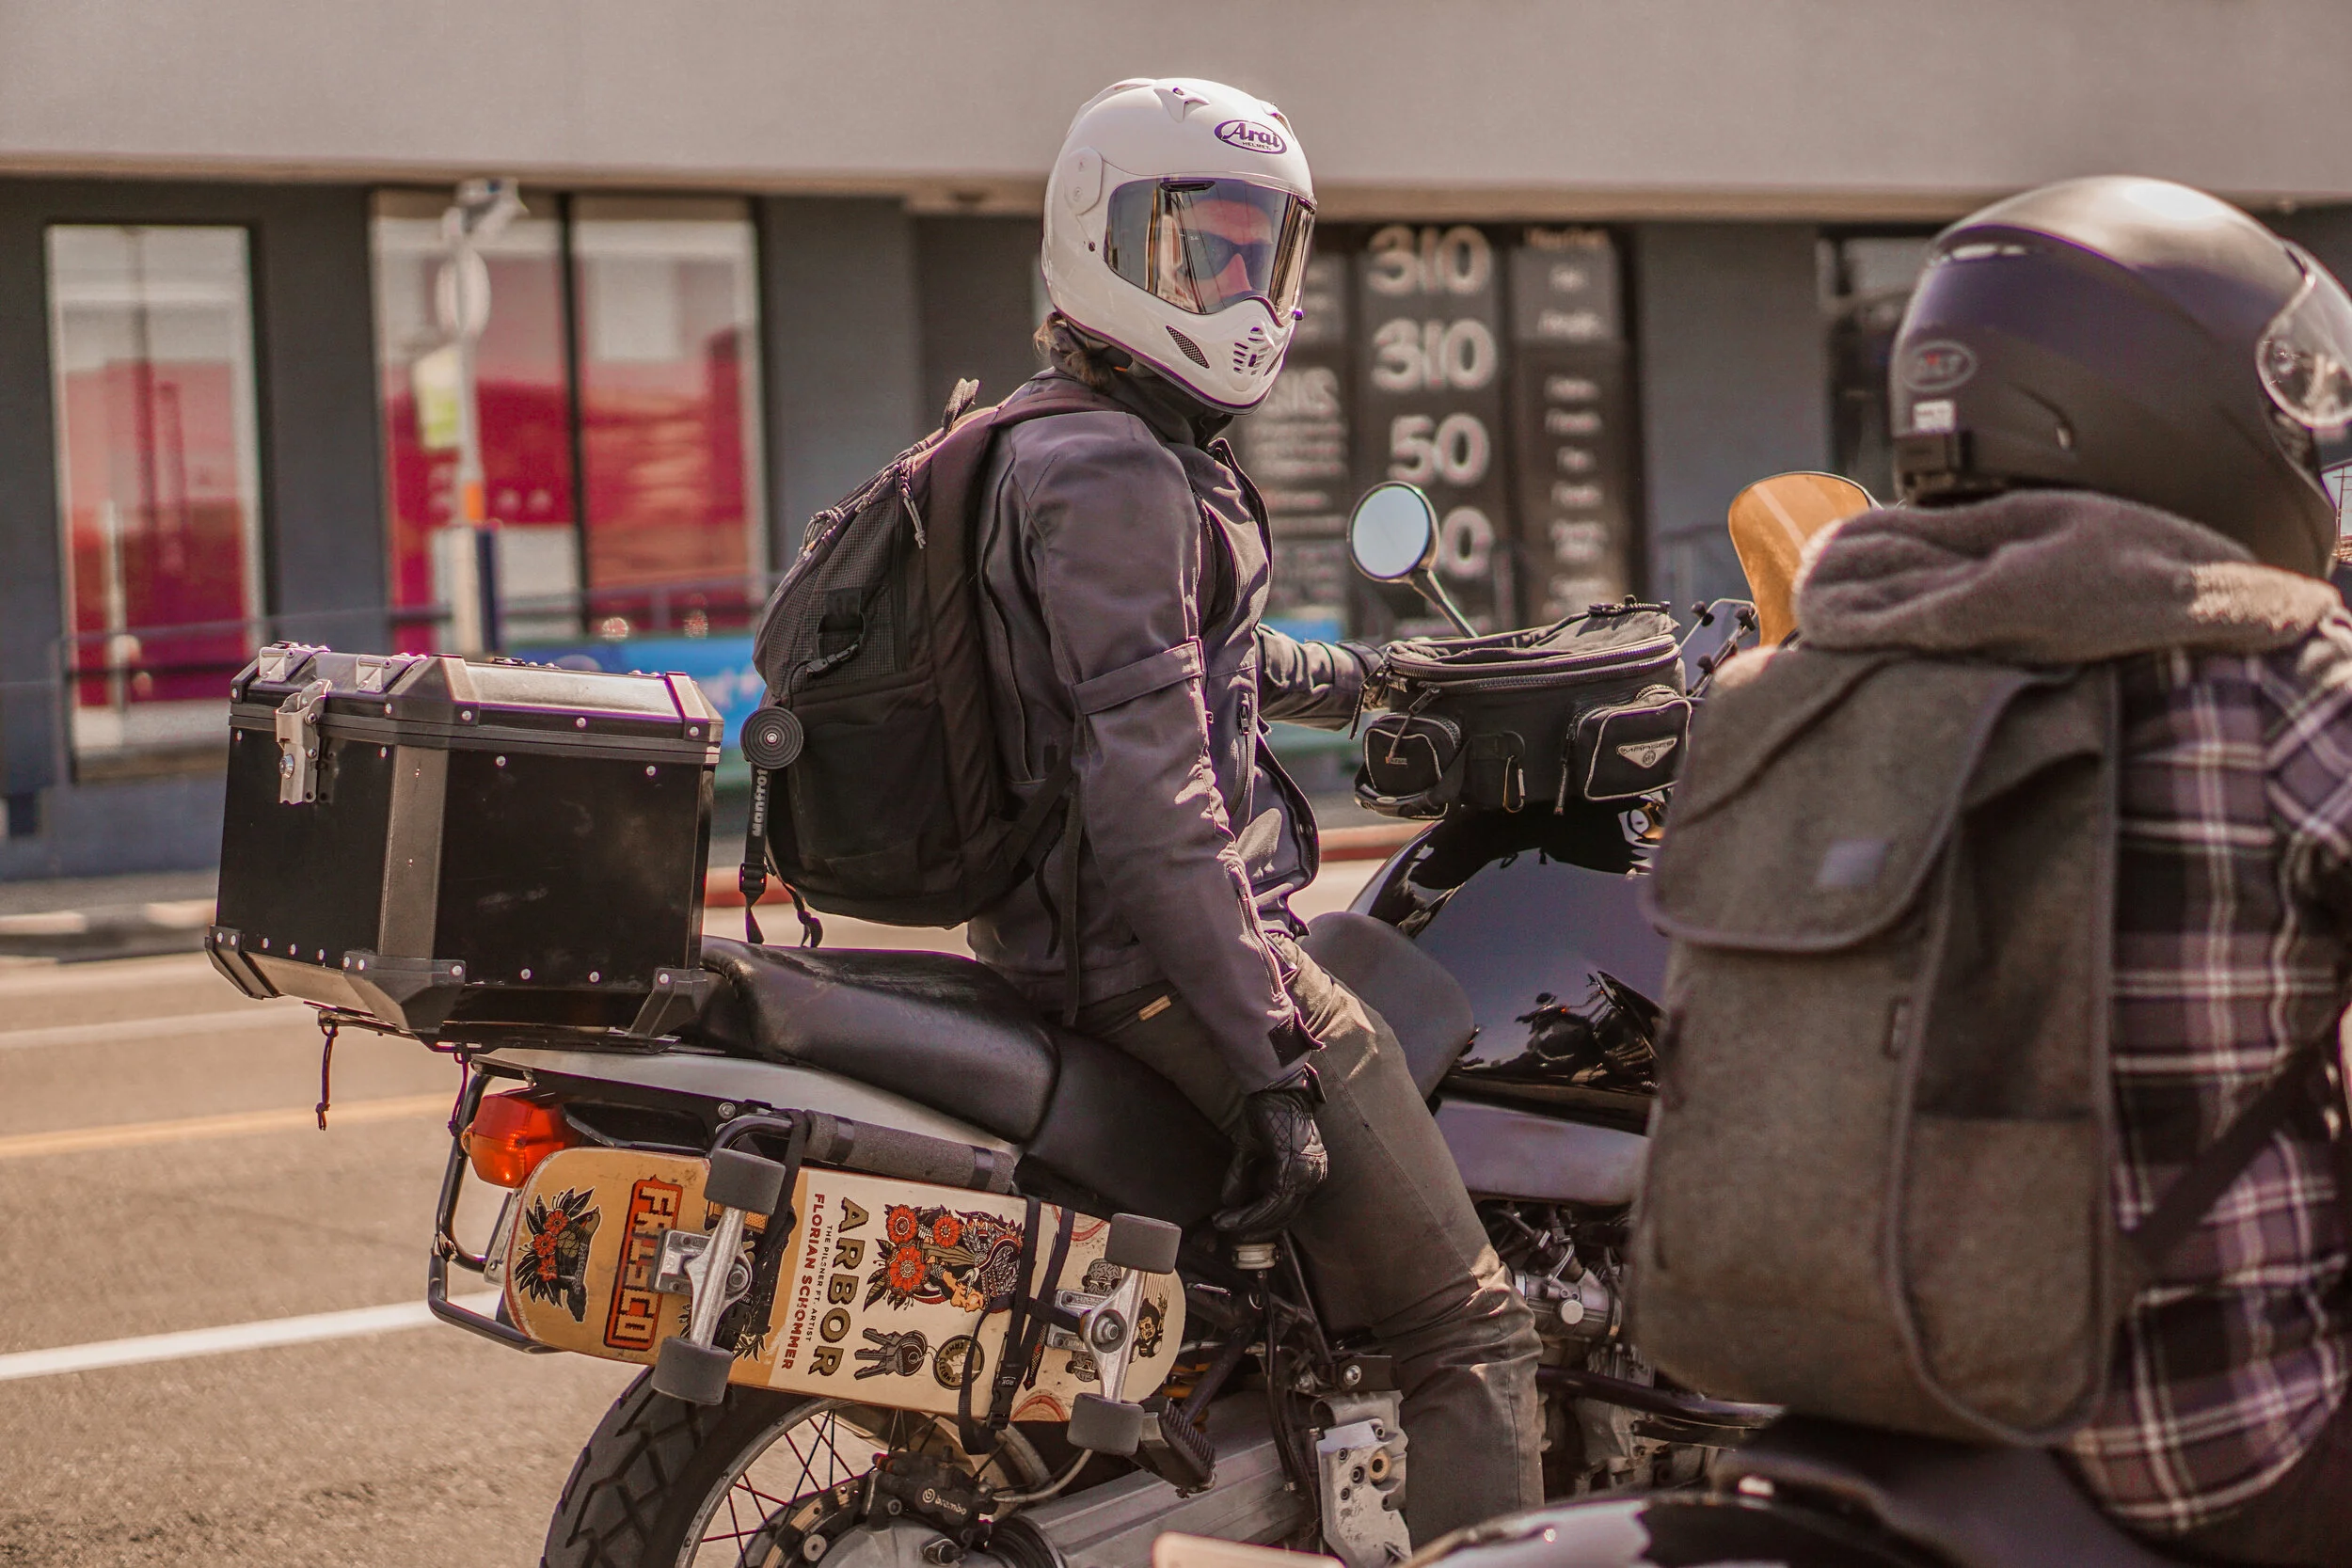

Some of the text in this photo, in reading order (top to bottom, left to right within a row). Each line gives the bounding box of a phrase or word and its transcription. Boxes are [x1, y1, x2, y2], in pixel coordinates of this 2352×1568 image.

[1222, 122, 1280, 148] Arai
[1368, 225, 1493, 295] 310
[1371, 318, 1499, 392] 310
[1388, 413, 1490, 488] 50
[824, 1225, 834, 1244] THE
[782, 1193, 826, 1370] FLORIAN SCHOMMER
[808, 1196, 869, 1377] ARBOR
[805, 1307, 818, 1342] ARTIST
[934, 1495, 967, 1515] brembo
